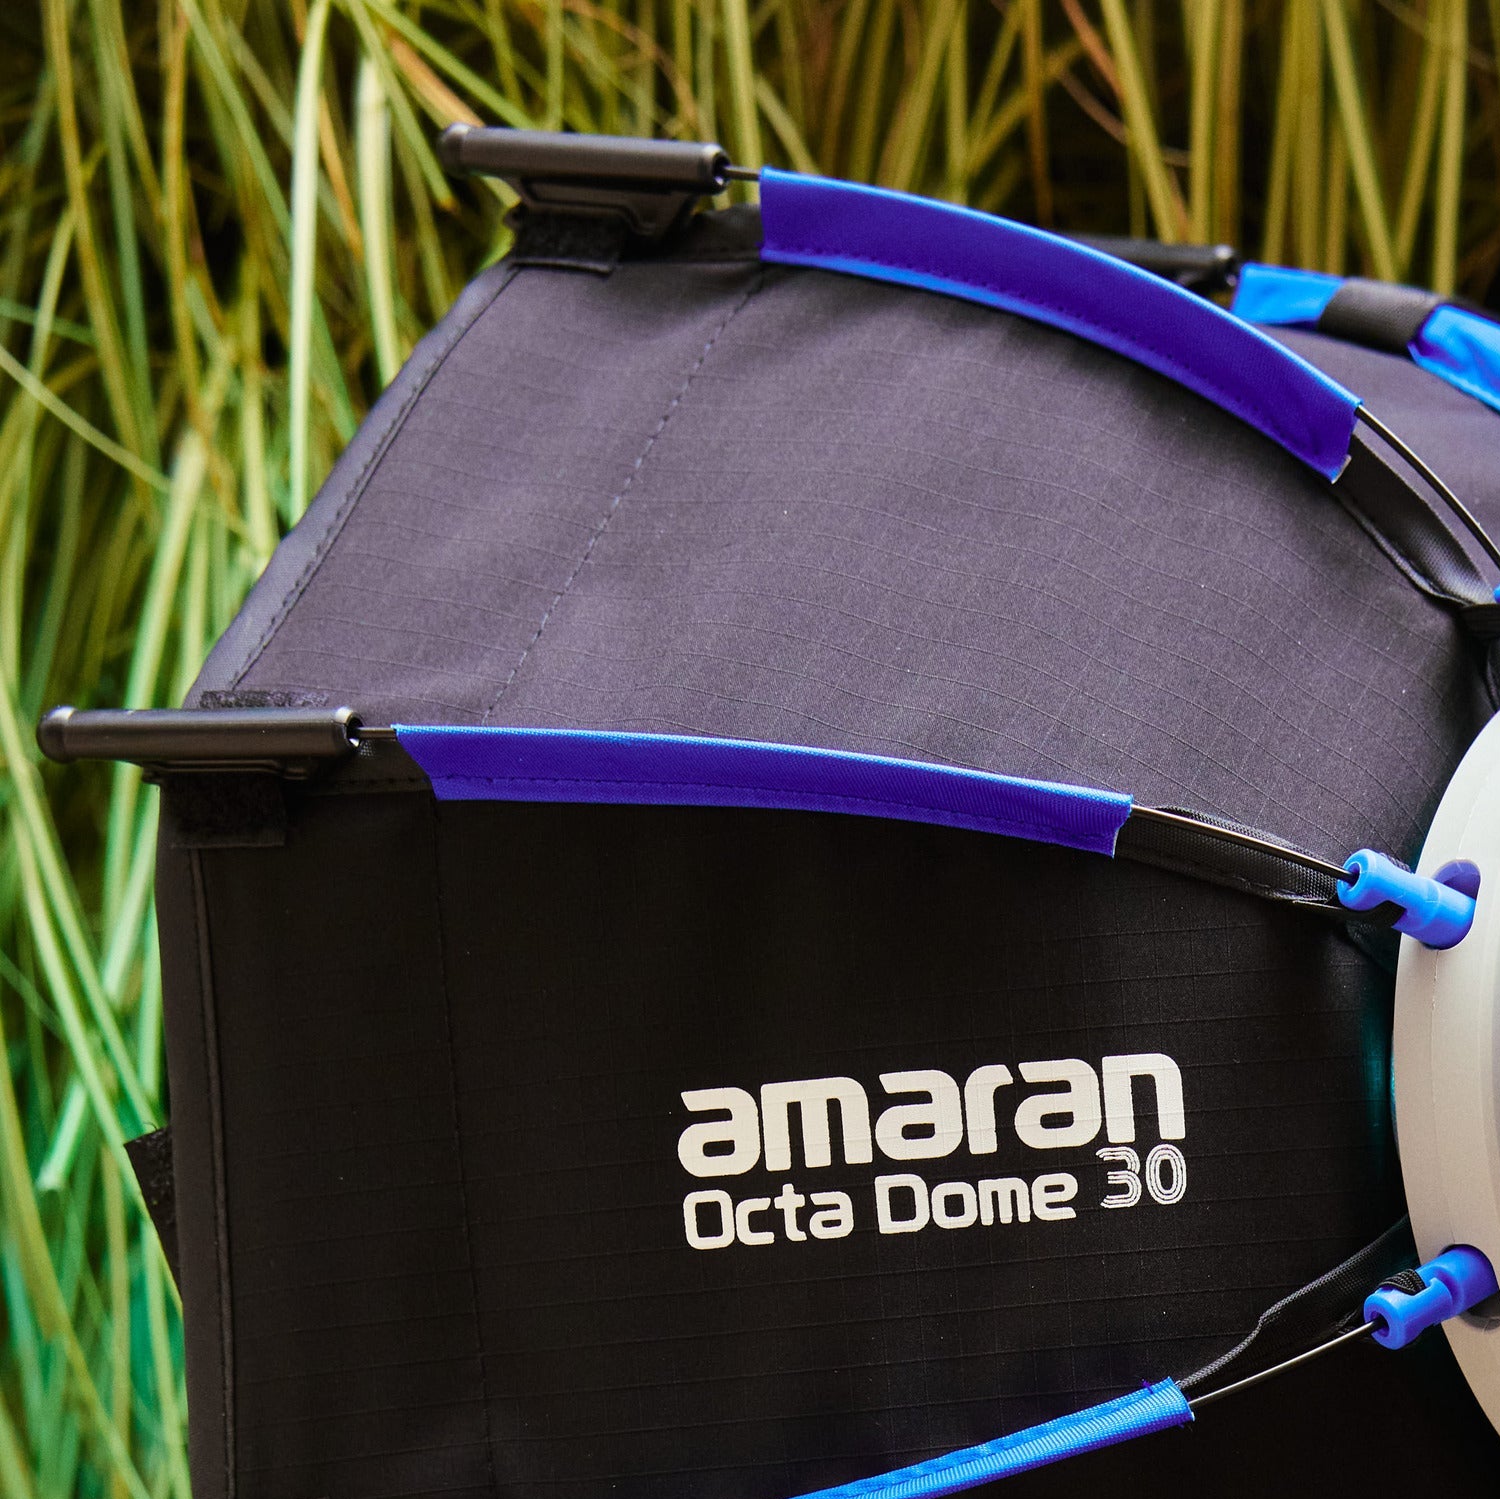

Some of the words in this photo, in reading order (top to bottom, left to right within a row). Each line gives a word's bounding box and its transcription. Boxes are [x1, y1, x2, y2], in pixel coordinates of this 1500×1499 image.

[678, 1053, 1187, 1178] amaran
[683, 1183, 855, 1250] Octa
[875, 1172, 1079, 1235] Dome
[1096, 1143, 1188, 1209] 30
